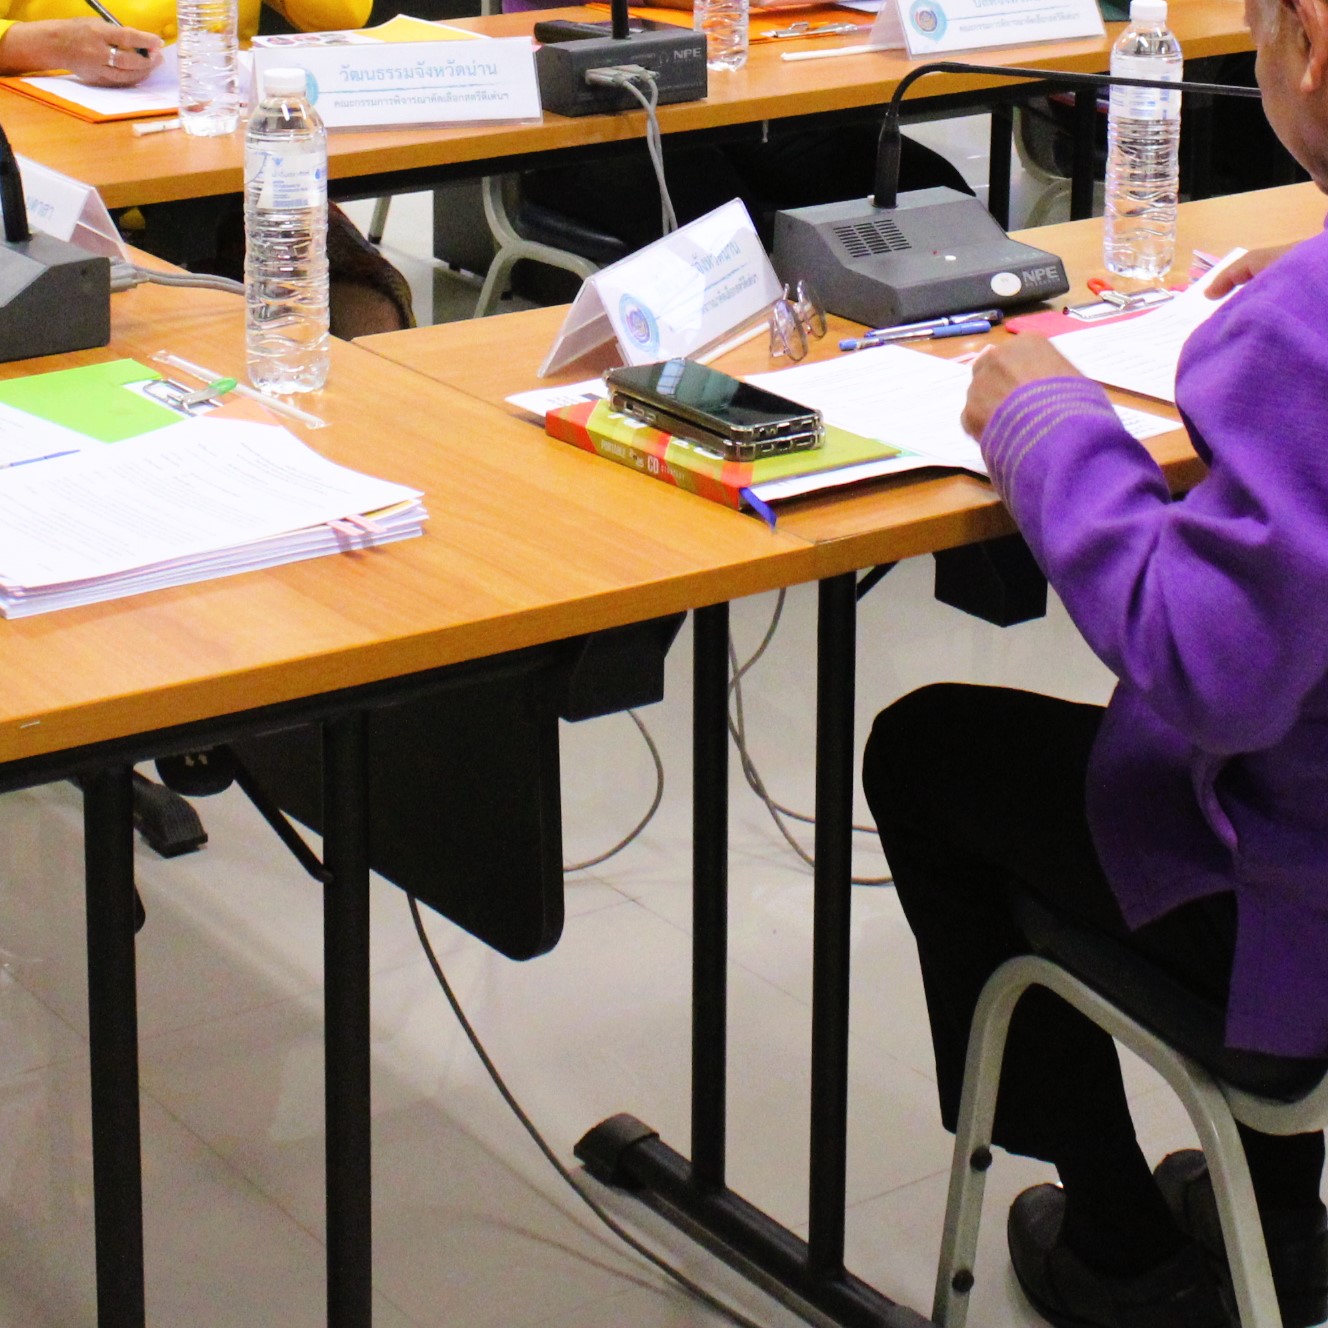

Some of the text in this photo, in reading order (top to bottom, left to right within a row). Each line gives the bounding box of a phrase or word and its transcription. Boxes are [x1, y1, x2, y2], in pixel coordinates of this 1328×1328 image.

[673, 47, 702, 60] NPE
[338, 59, 498, 83] วัฒนธรรมจังหวัดน่าน
[1021, 265, 1060, 283] NPE
[647, 454, 660, 475] CD
